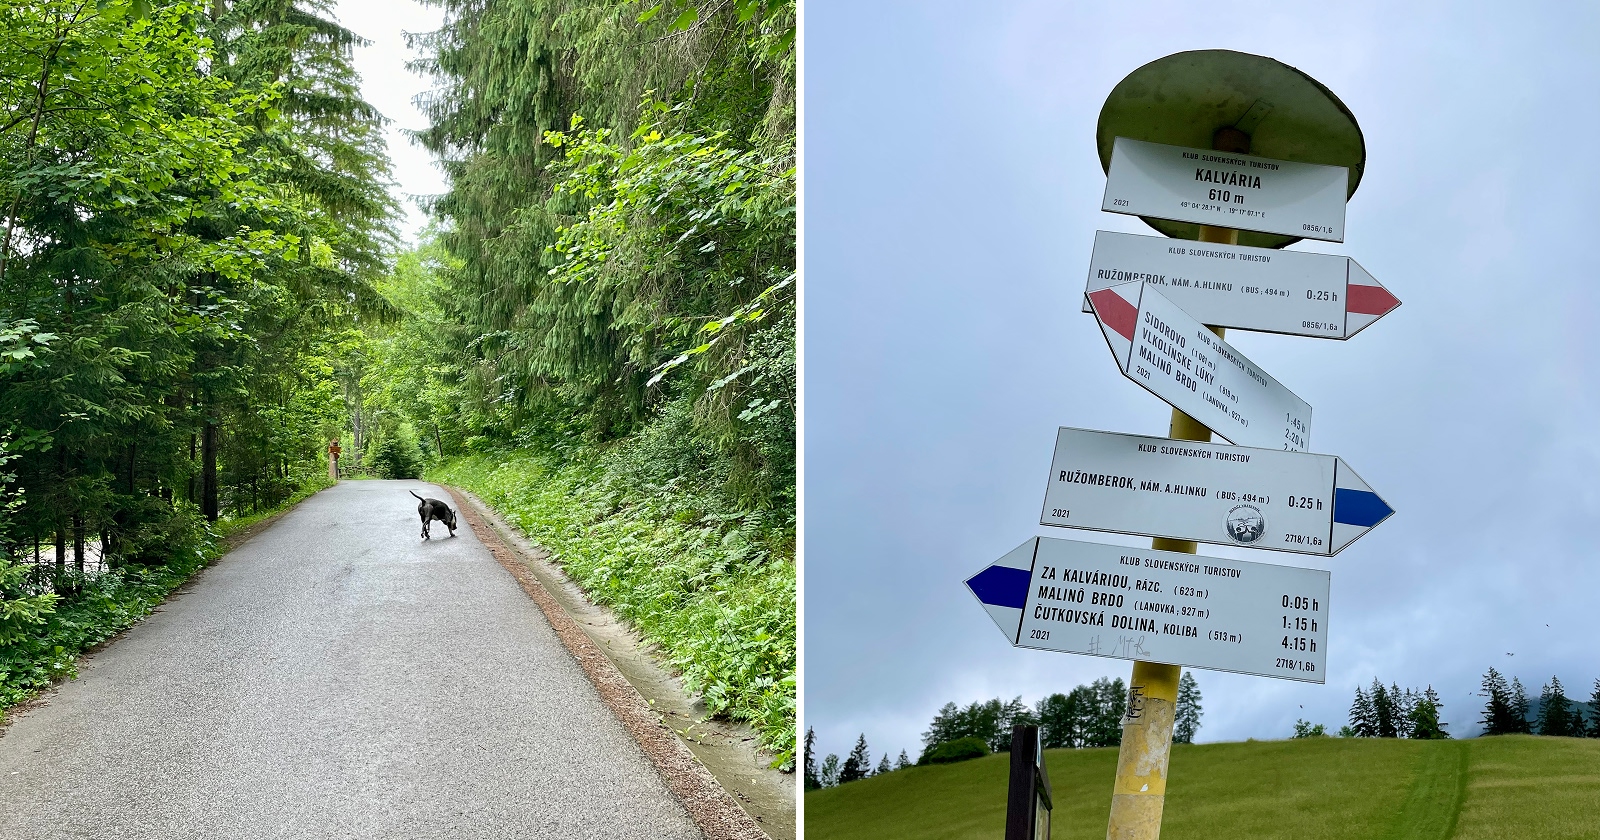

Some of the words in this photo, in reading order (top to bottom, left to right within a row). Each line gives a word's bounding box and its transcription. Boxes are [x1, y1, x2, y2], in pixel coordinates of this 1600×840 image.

[1182, 152, 1199, 160] KLUB
[1202, 155, 1246, 166] SLOVENSKÝCH
[1249, 161, 1280, 170] TURISTOV
[1195, 168, 1261, 189] KALVÁRIA
[1113, 198, 1130, 207] 2021
[1208, 189, 1231, 203] 610
[1233, 194, 1244, 204] m
[1168, 246, 1186, 255] KLUB
[1189, 248, 1236, 260] SLOVENSKÝCH
[1239, 253, 1271, 263] TURISTOV
[1171, 277, 1192, 288] NÁM.
[1193, 280, 1233, 292] A.HLINKU
[1306, 289, 1330, 301] 0:25
[1332, 292, 1338, 302] h
[1144, 311, 1186, 349] SIDOROVO
[1142, 327, 1192, 371] VLKOLÍNSKE
[1195, 364, 1215, 386] LÚKY
[1197, 330, 1211, 346] KLUB
[1212, 341, 1246, 372] SLOVENSKÝCH
[1246, 366, 1268, 388] TURISTOV
[1136, 365, 1151, 381] 2021
[1139, 344, 1172, 376] MALINÔ
[1175, 369, 1197, 393] BRDO
[1286, 412, 1301, 430] 1:45
[1285, 428, 1300, 446] 2:20
[1138, 443, 1157, 453] KLUB
[1160, 446, 1212, 459] SLOVENSKÝCH
[1215, 451, 1250, 463] TURISTOV
[1059, 469, 1137, 491] RUŽOMBEROK,
[1140, 480, 1162, 493] NÁM.
[1164, 483, 1207, 498] A.HLINKU
[1288, 495, 1313, 510] 0:25
[1316, 499, 1323, 511] h
[1052, 508, 1070, 518] 2021
[1119, 555, 1140, 566] KLUB
[1144, 558, 1199, 573] SLOVENSKÝCH
[1203, 565, 1241, 578] TURISTOV
[1041, 566, 1056, 580] ZA
[1063, 568, 1131, 591] KALVÁRIOU,
[1135, 578, 1163, 593] RÁZC.
[1038, 585, 1084, 603] MALINÔ
[1091, 591, 1124, 608] BRDO
[1282, 594, 1309, 610] 0:05
[1312, 598, 1319, 611] h
[1034, 603, 1105, 627] ČUTKOVSKÁ
[1111, 614, 1159, 635] DOLINA,
[1163, 623, 1198, 638] KOLIBA
[1282, 615, 1308, 631] 1:15
[1311, 618, 1318, 632] h
[1030, 629, 1050, 641] 2021
[1281, 635, 1306, 651] 4:15
[1309, 638, 1317, 652] h
